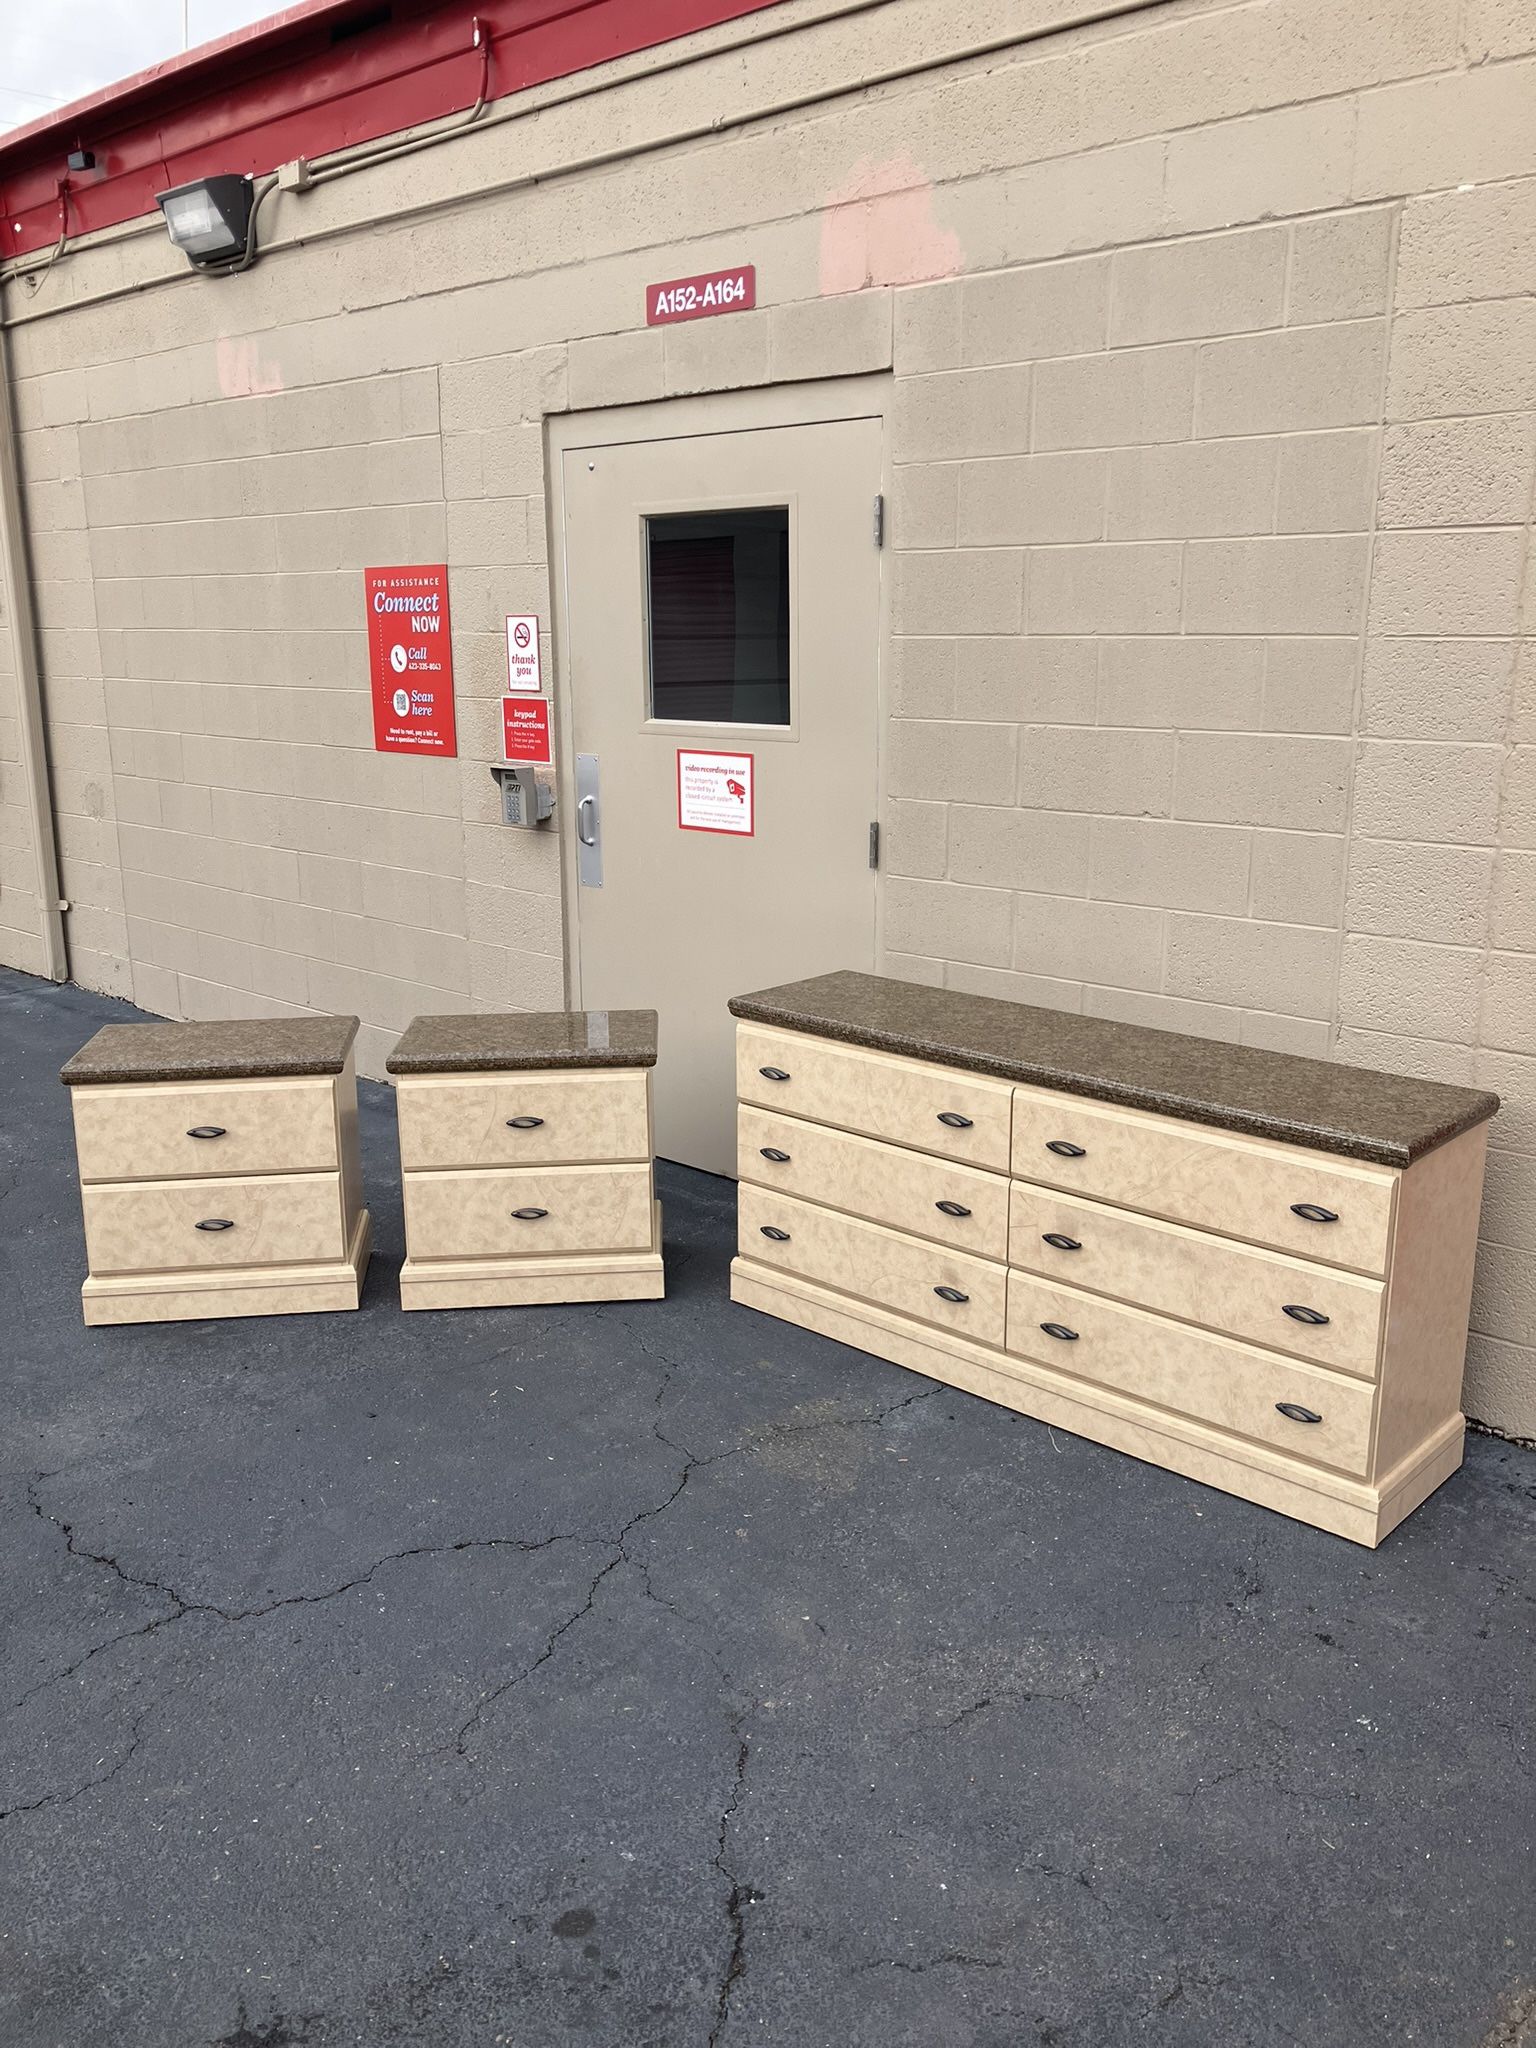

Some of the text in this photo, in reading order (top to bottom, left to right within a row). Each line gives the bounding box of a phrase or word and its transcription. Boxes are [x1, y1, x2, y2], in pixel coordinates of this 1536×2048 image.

[655, 276, 745, 316] A152-A164
[372, 577, 439, 588] FOR ASSISTANCE
[373, 591, 440, 613] Connect
[411, 615, 440, 633] NOW
[408, 646, 427, 660] Call
[511, 653, 536, 665] thank
[516, 667, 532, 678] you
[411, 689, 434, 703] Scan
[411, 702, 433, 716] here
[514, 709, 536, 719] keypad
[507, 719, 545, 729] instructions
[418, 737, 434, 745] Connect
[685, 764, 700, 773] video
[701, 766, 728, 775] recording
